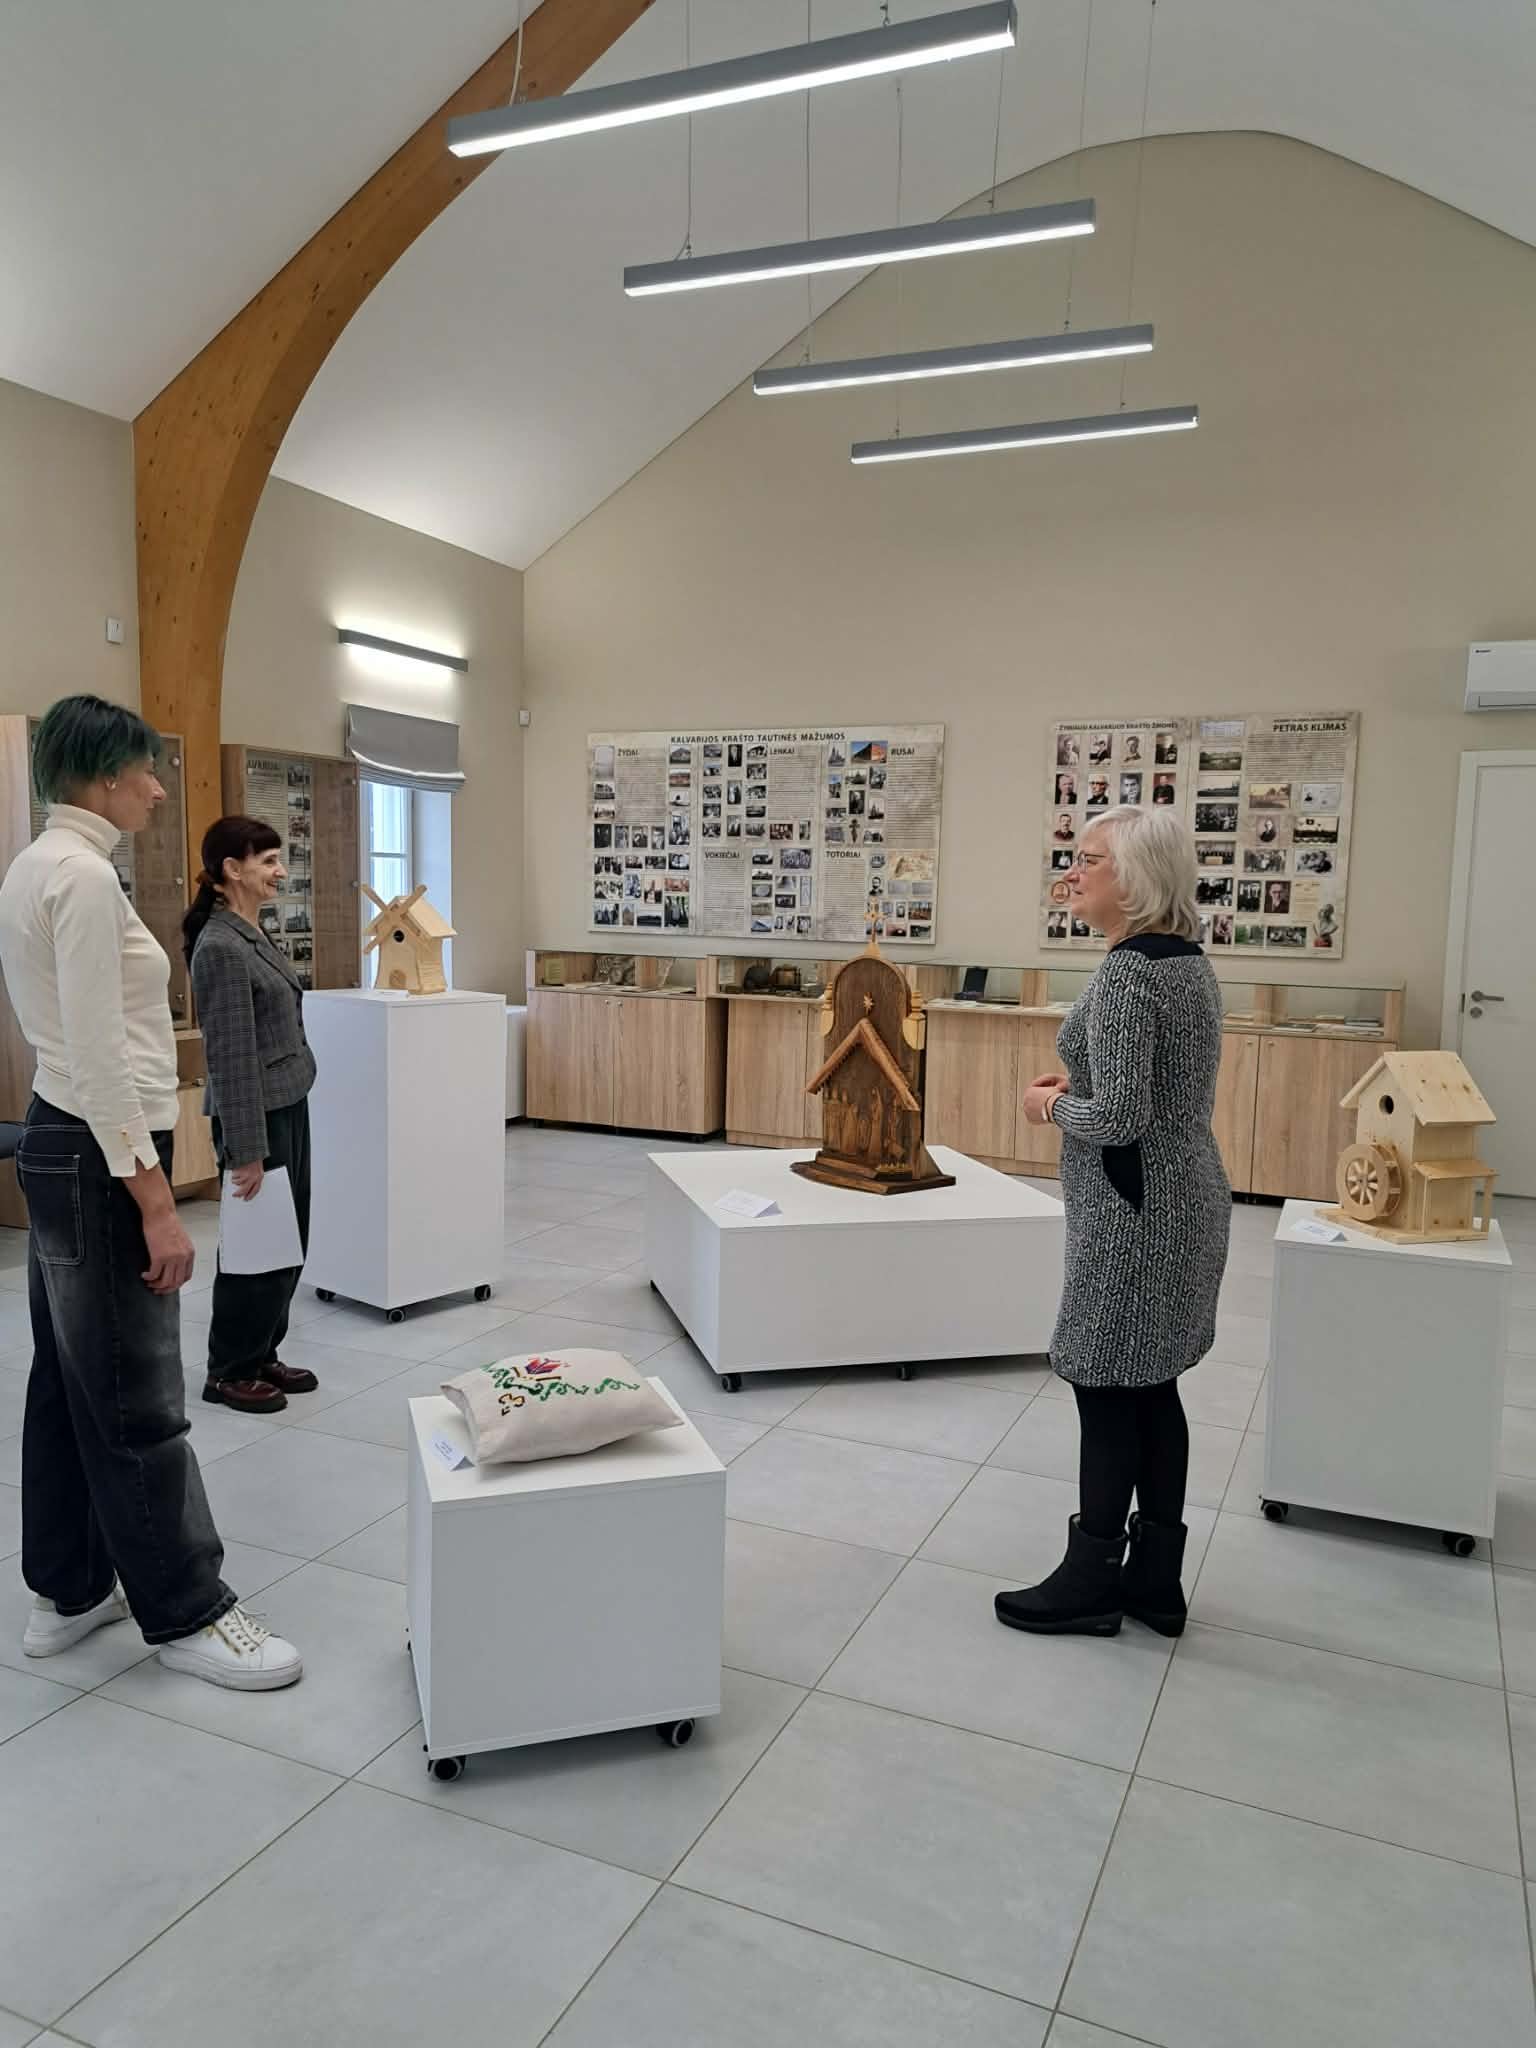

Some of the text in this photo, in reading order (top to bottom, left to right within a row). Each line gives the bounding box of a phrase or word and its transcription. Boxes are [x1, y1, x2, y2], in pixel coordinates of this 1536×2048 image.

[1273, 723, 1347, 732] PETRAS KLIMAS
[671, 732, 845, 743] KALVARIJOS KRAŠTO TAUTINĖS MAŽUMOS
[769, 747, 795, 755] LENKAI
[891, 747, 915, 755] RUSAI
[825, 850, 861, 858] TOTORIAI
